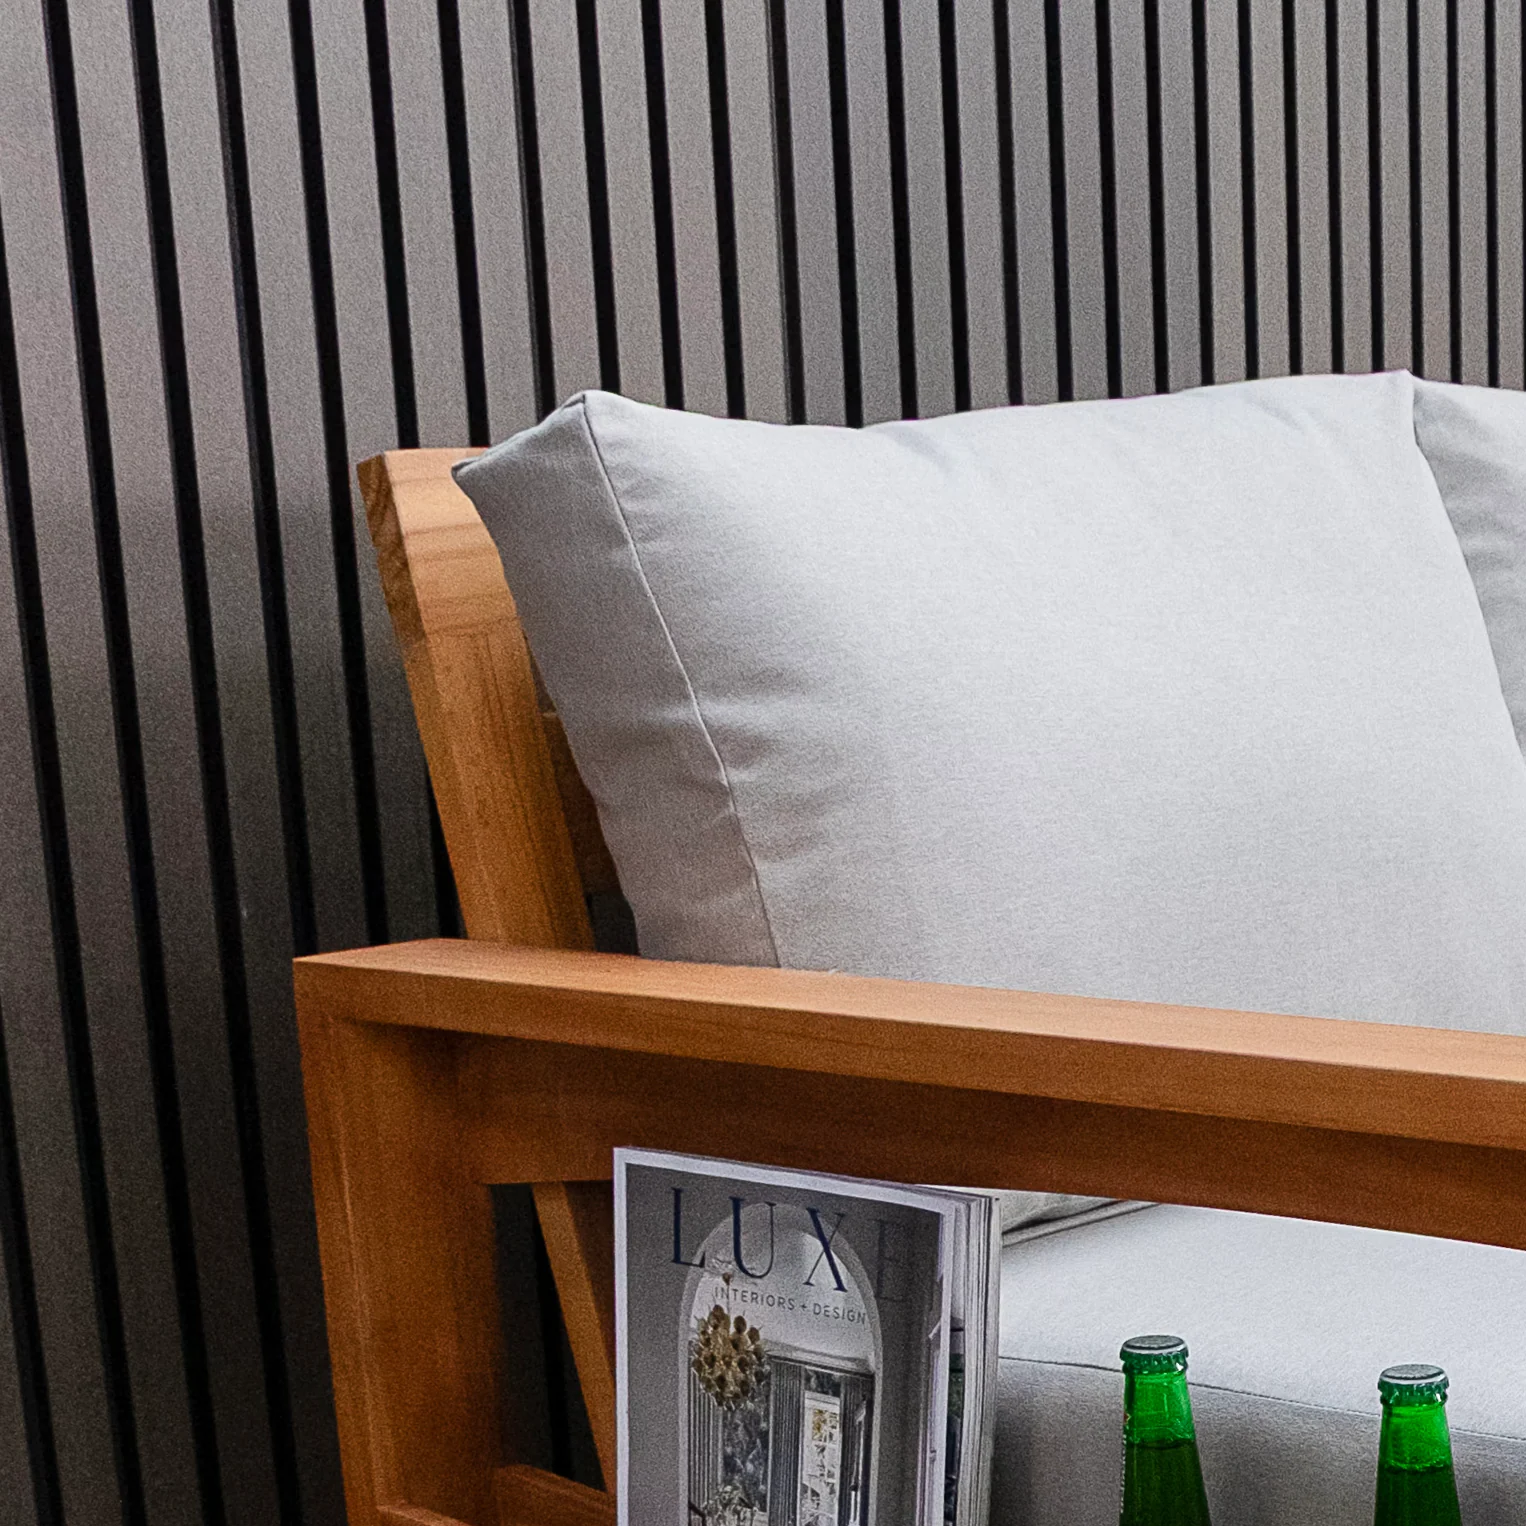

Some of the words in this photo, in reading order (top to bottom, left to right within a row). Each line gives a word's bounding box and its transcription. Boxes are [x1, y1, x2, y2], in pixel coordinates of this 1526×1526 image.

[671, 1187, 913, 1303] LUXE
[713, 1286, 795, 1311] INTERIORS
[813, 1303, 866, 1324] DESIGN
